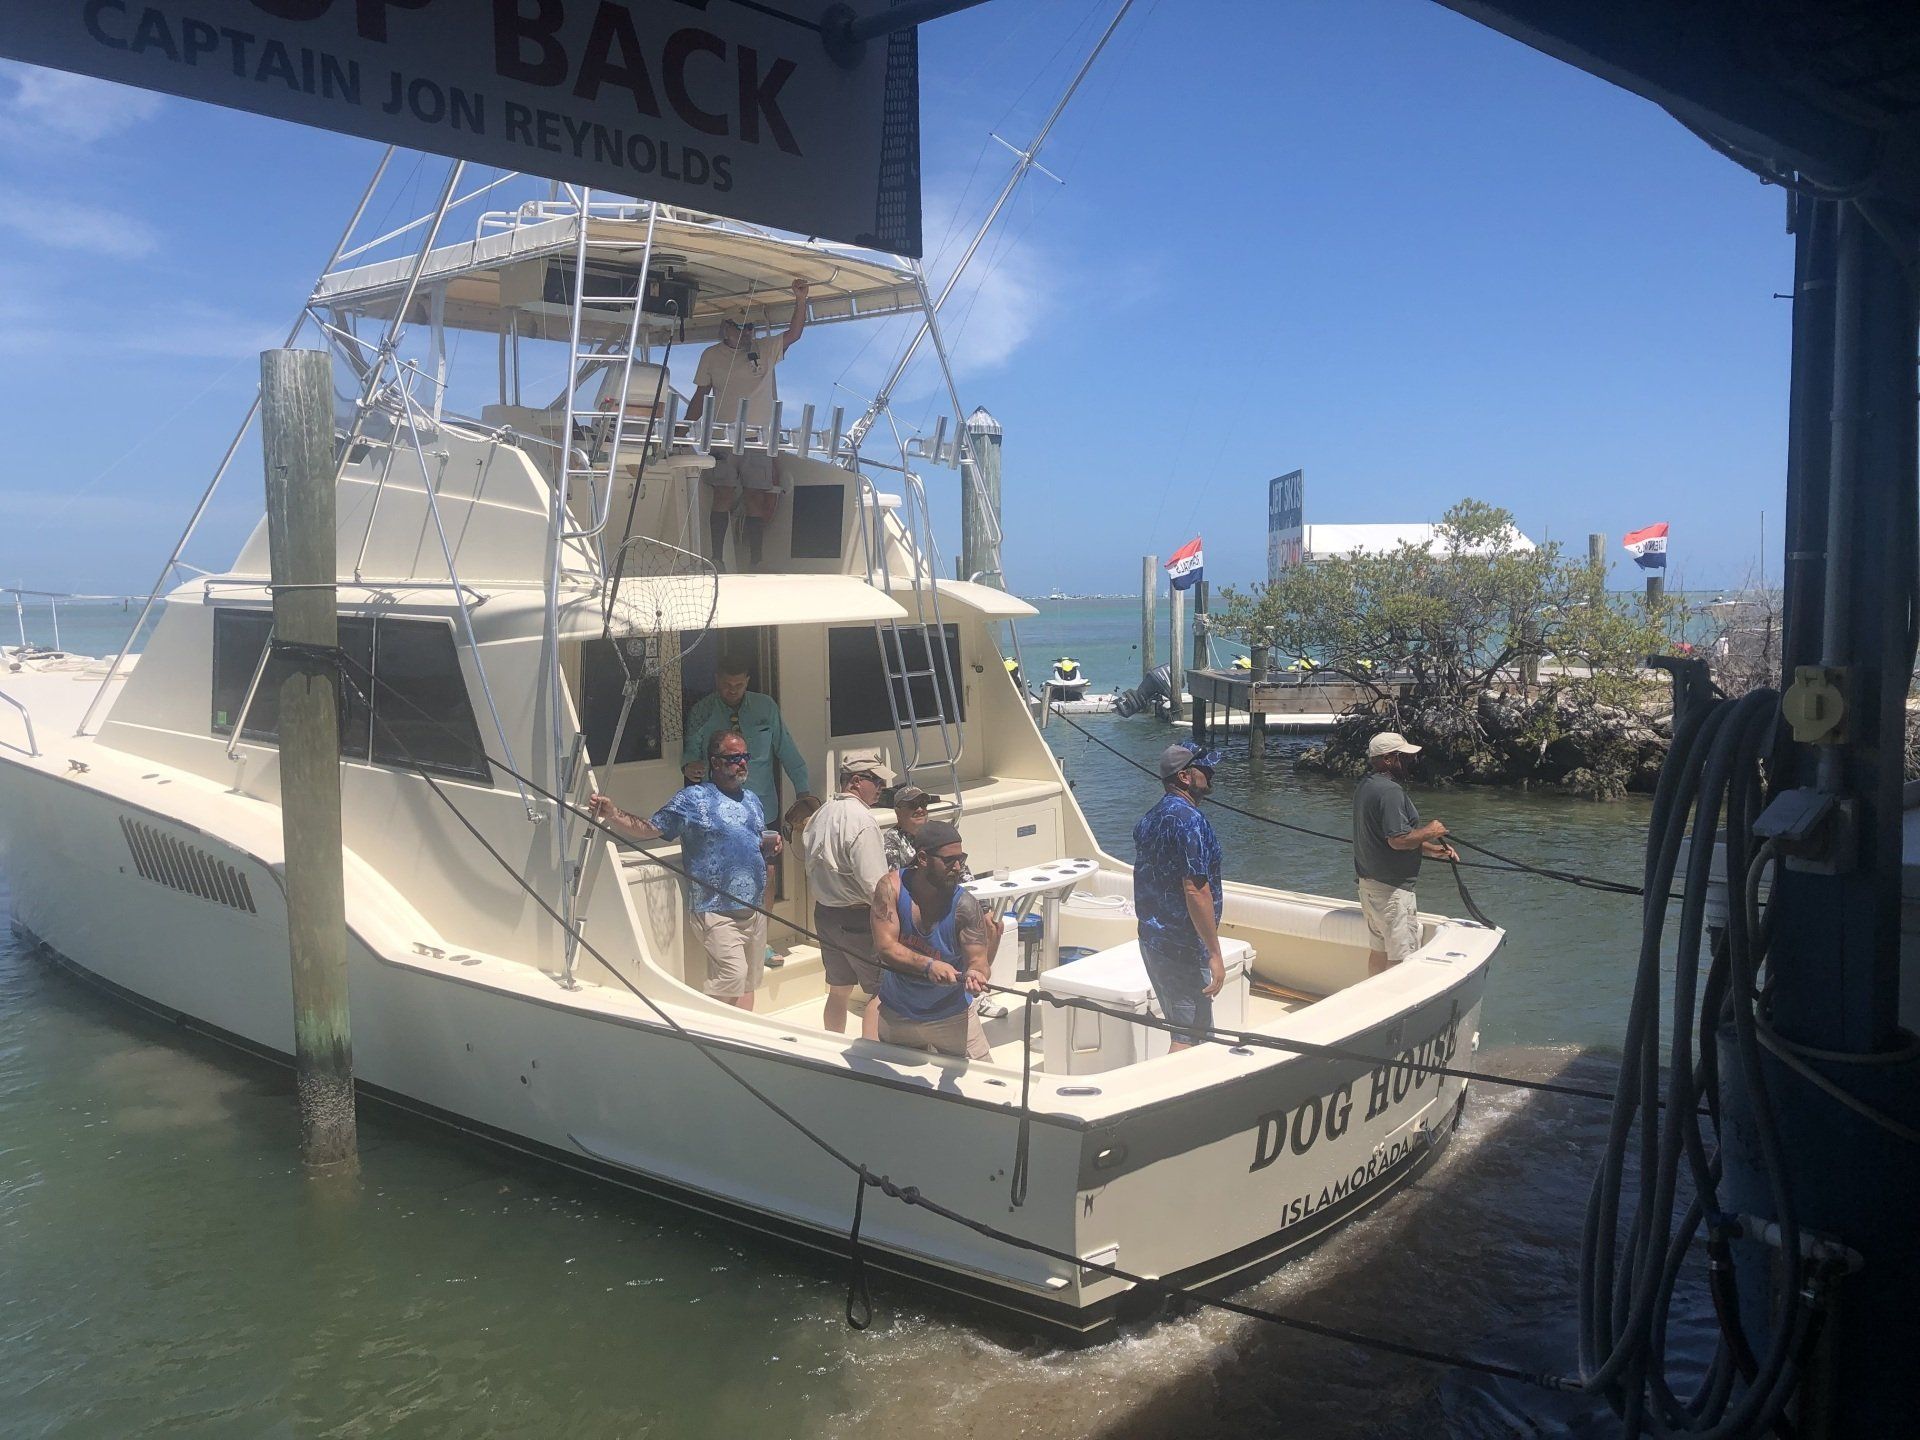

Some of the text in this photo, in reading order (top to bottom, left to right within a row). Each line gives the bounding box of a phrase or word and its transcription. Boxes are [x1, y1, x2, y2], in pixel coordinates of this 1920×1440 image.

[83, 0, 361, 105] CAPTAIN
[382, 71, 486, 136] JON
[505, 100, 734, 193] REYNOLDS
[493, 0, 803, 157] BACK
[1270, 475, 1301, 515] JET SKIS
[1249, 1012, 1458, 1174] DOG HOUSE
